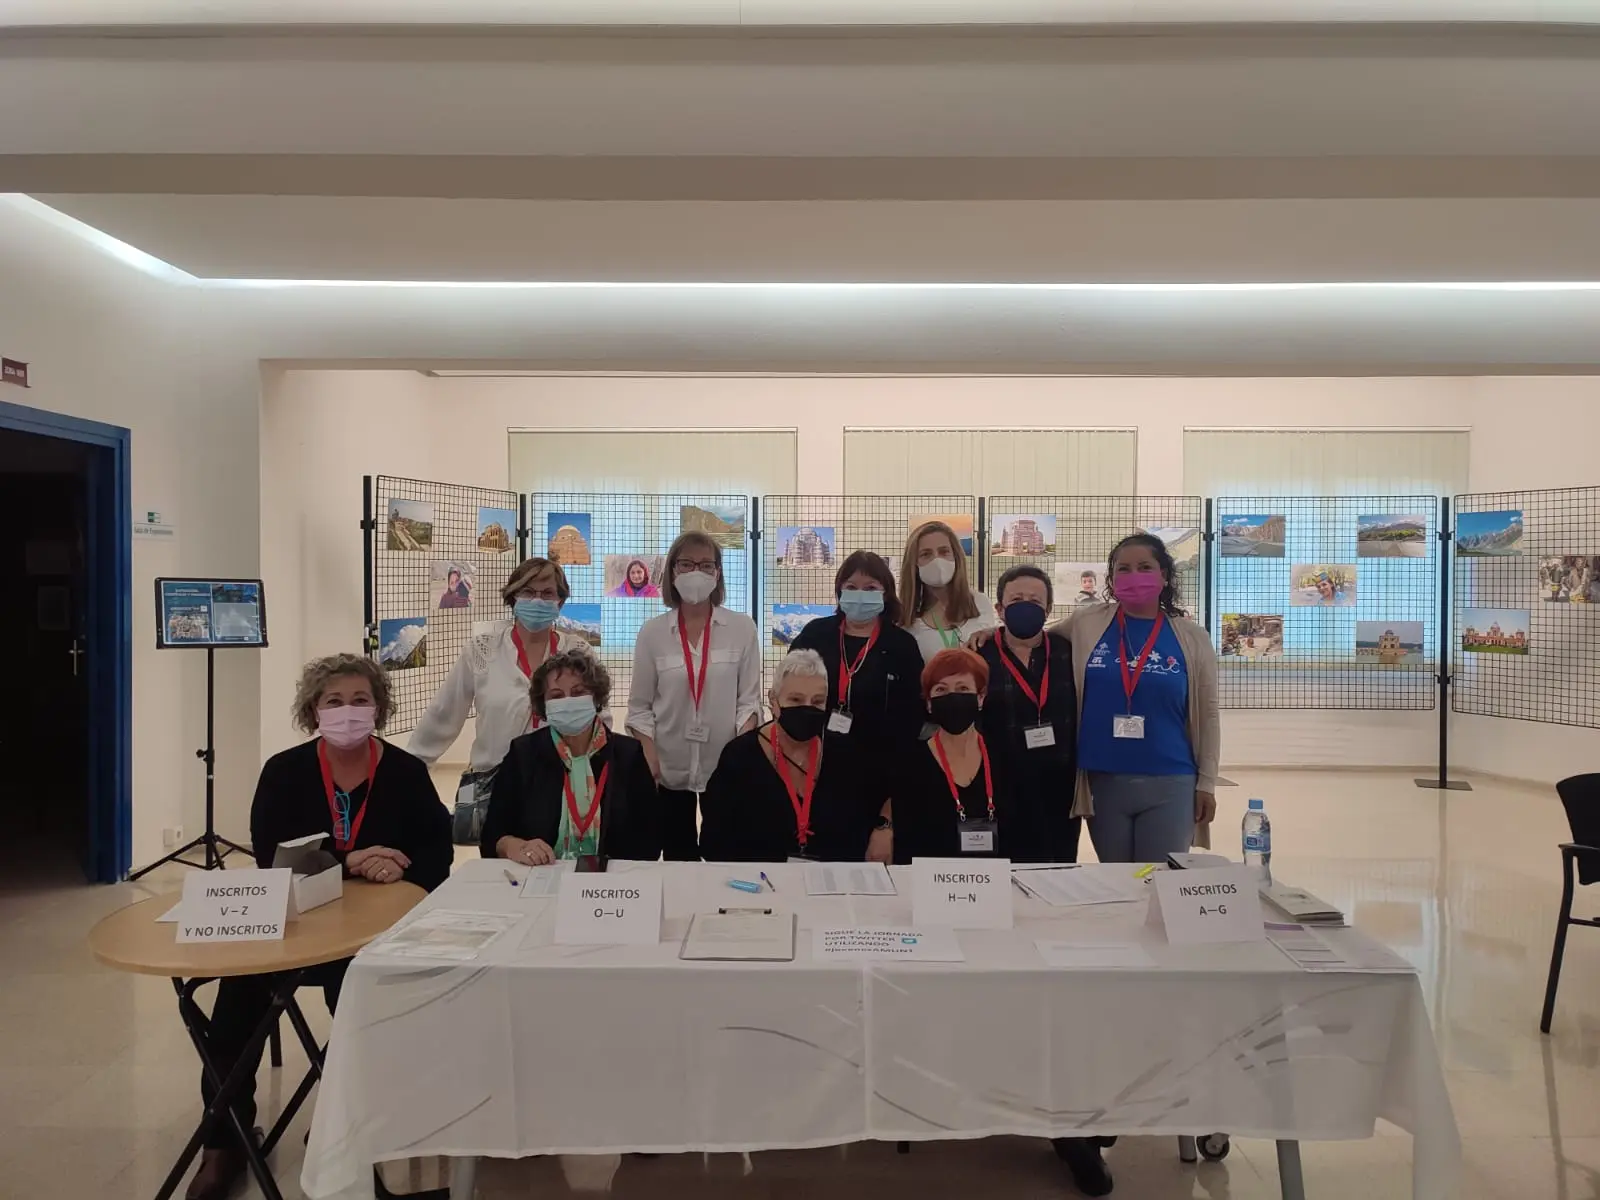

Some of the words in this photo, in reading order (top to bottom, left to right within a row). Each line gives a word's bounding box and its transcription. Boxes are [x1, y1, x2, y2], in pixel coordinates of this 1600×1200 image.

[933, 873, 991, 884] INSCRITOS
[205, 886, 268, 897] INSCRITOS
[581, 889, 640, 899] INSCRITOS
[1179, 883, 1237, 896] INSCRITOS
[184, 927, 192, 937] Y
[194, 926, 214, 937] NO
[216, 924, 278, 936] INSCRITOS
